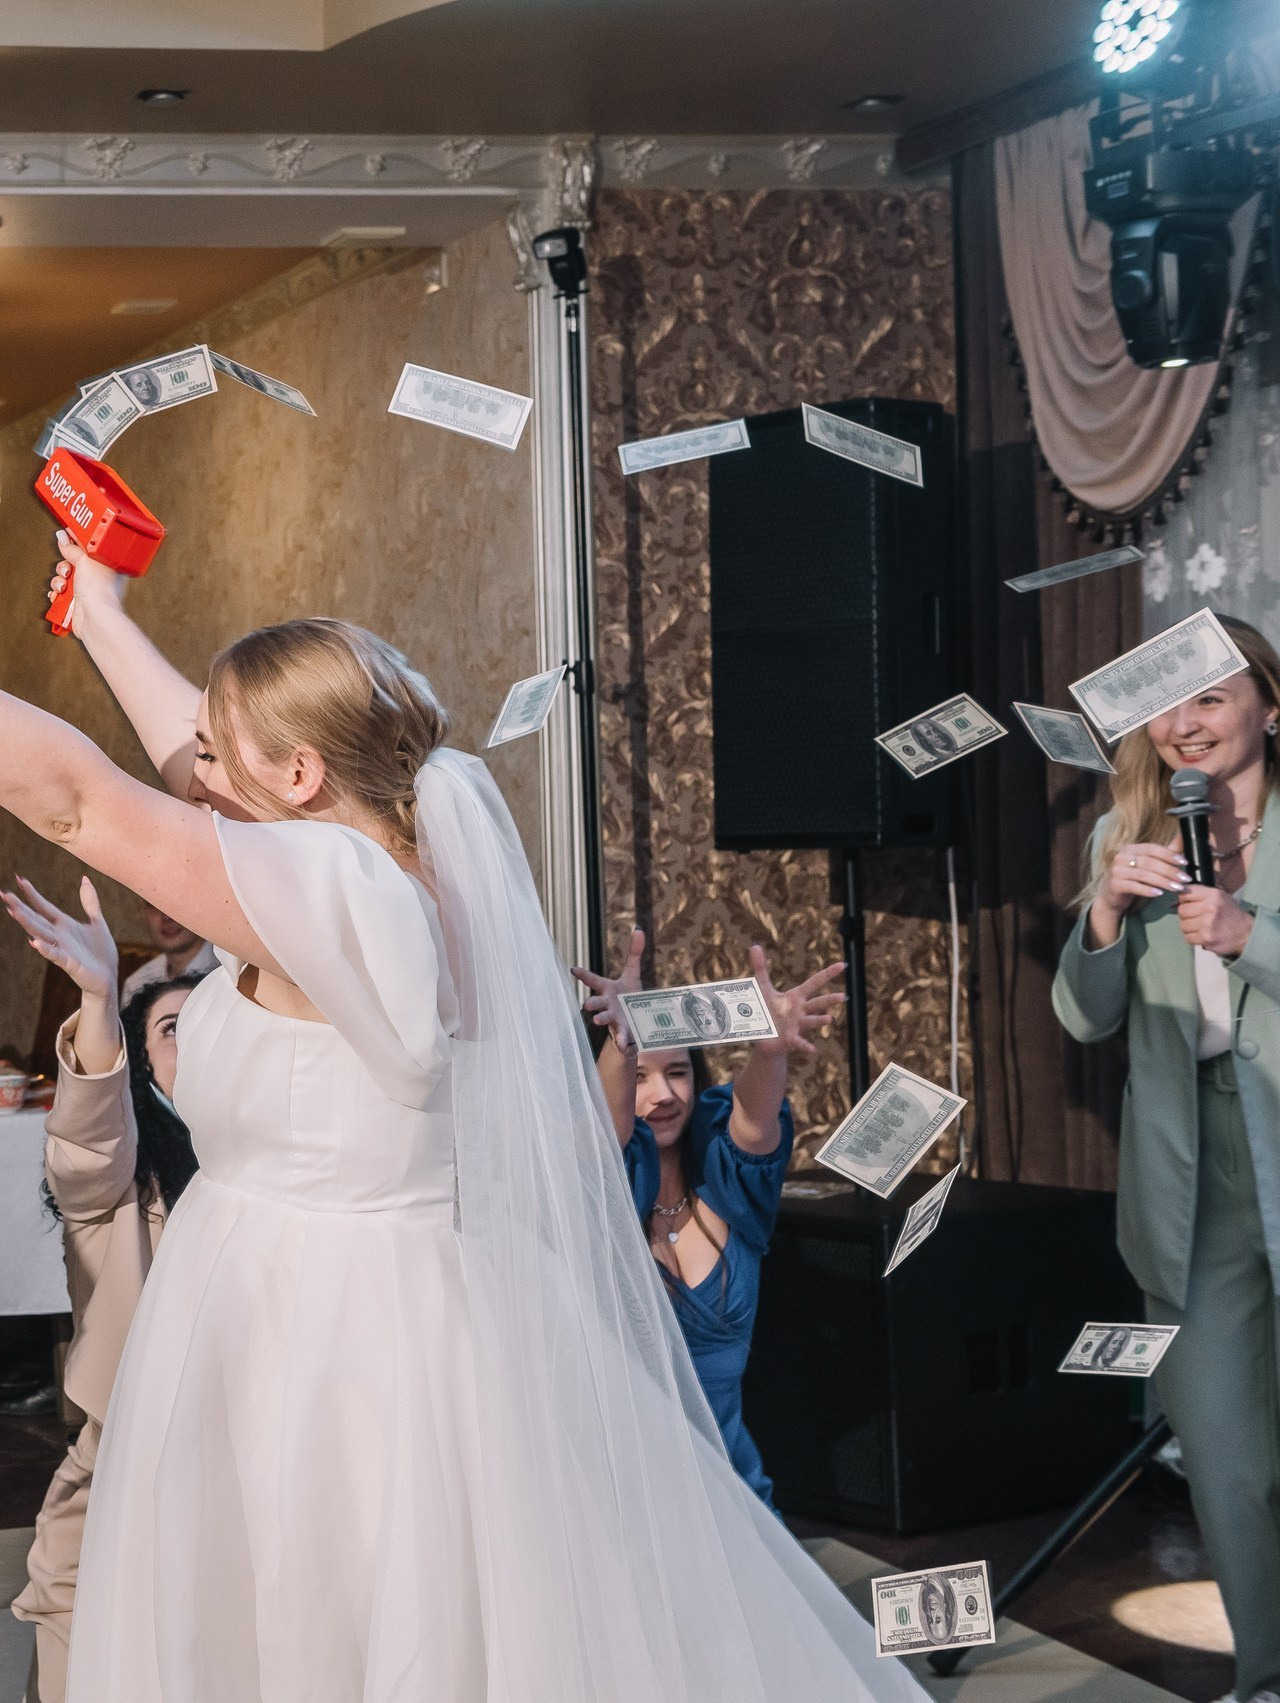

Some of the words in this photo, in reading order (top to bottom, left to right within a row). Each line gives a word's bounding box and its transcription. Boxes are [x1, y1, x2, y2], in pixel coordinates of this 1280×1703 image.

[188, 381, 206, 391] 100
[116, 405, 132, 422] 100
[45, 462, 76, 507] Super
[70, 492, 94, 529] Gun
[976, 725, 993, 735] 100
[630, 1001, 651, 1009] 100
[880, 1590, 895, 1598] 100
